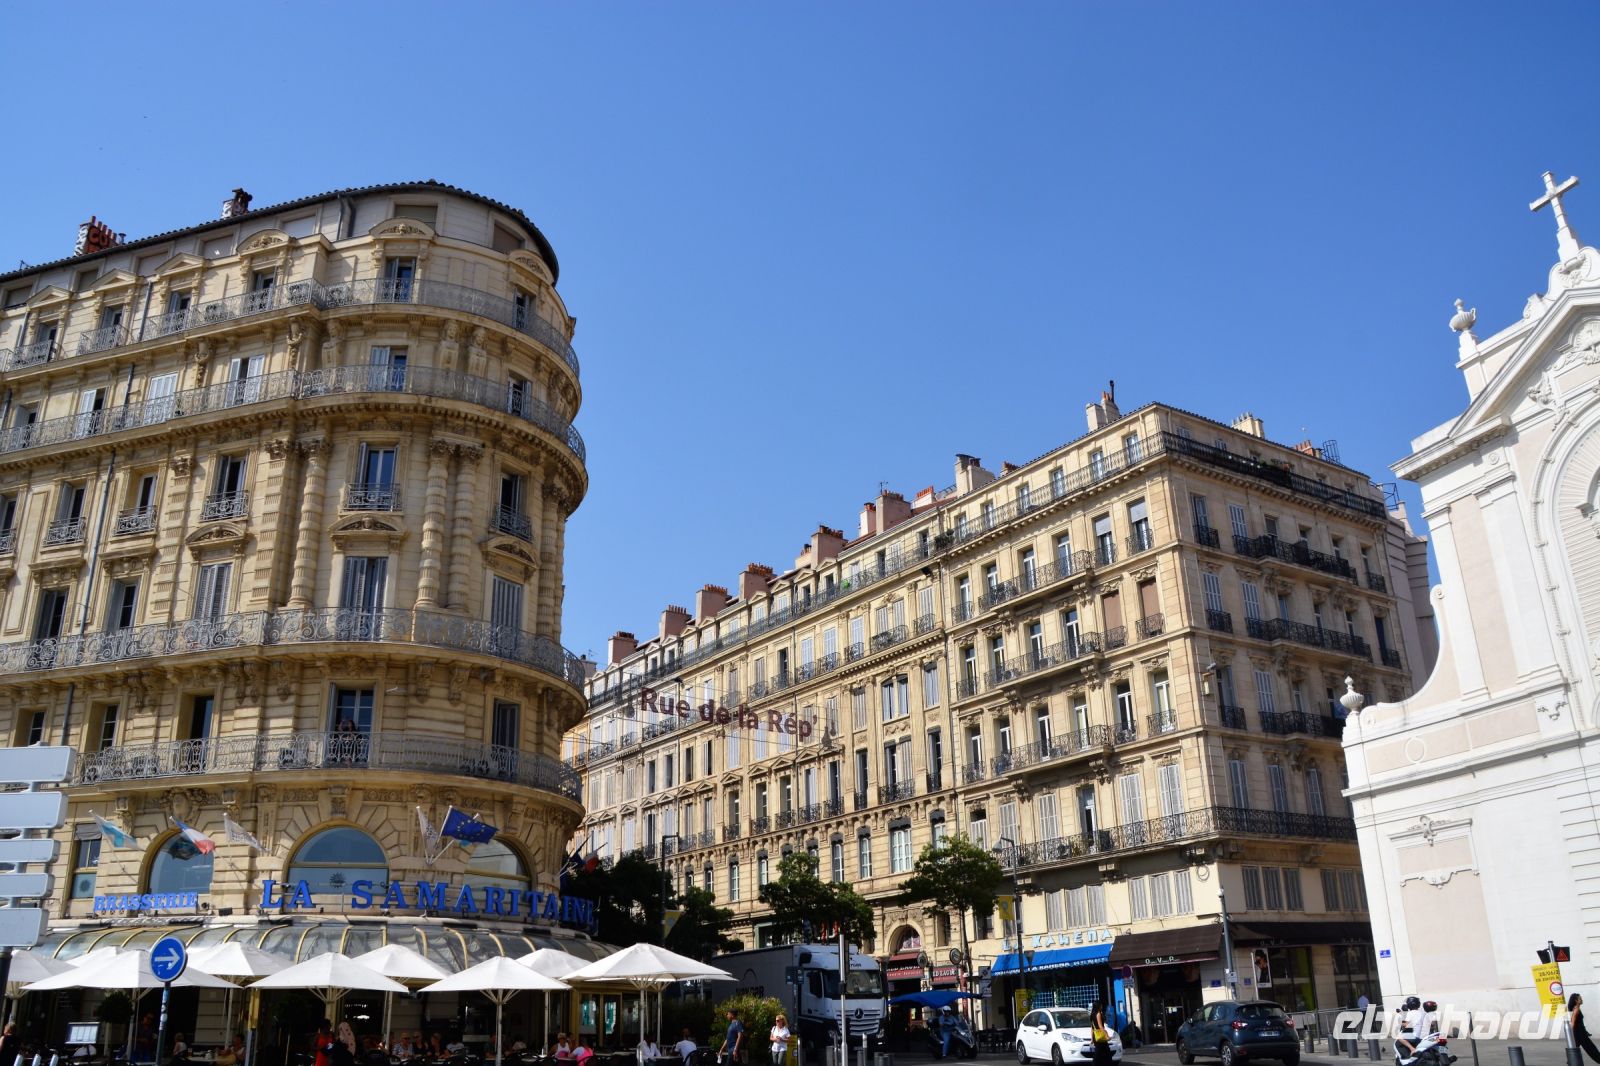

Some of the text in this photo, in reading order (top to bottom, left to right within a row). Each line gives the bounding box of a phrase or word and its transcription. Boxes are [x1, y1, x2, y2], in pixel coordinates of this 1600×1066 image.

[641, 687, 690, 719] Rue
[698, 699, 730, 725] de
[738, 704, 759, 730] la
[94, 892, 198, 911] BRASSERIE
[260, 879, 595, 926] LA SAMARITAINE
